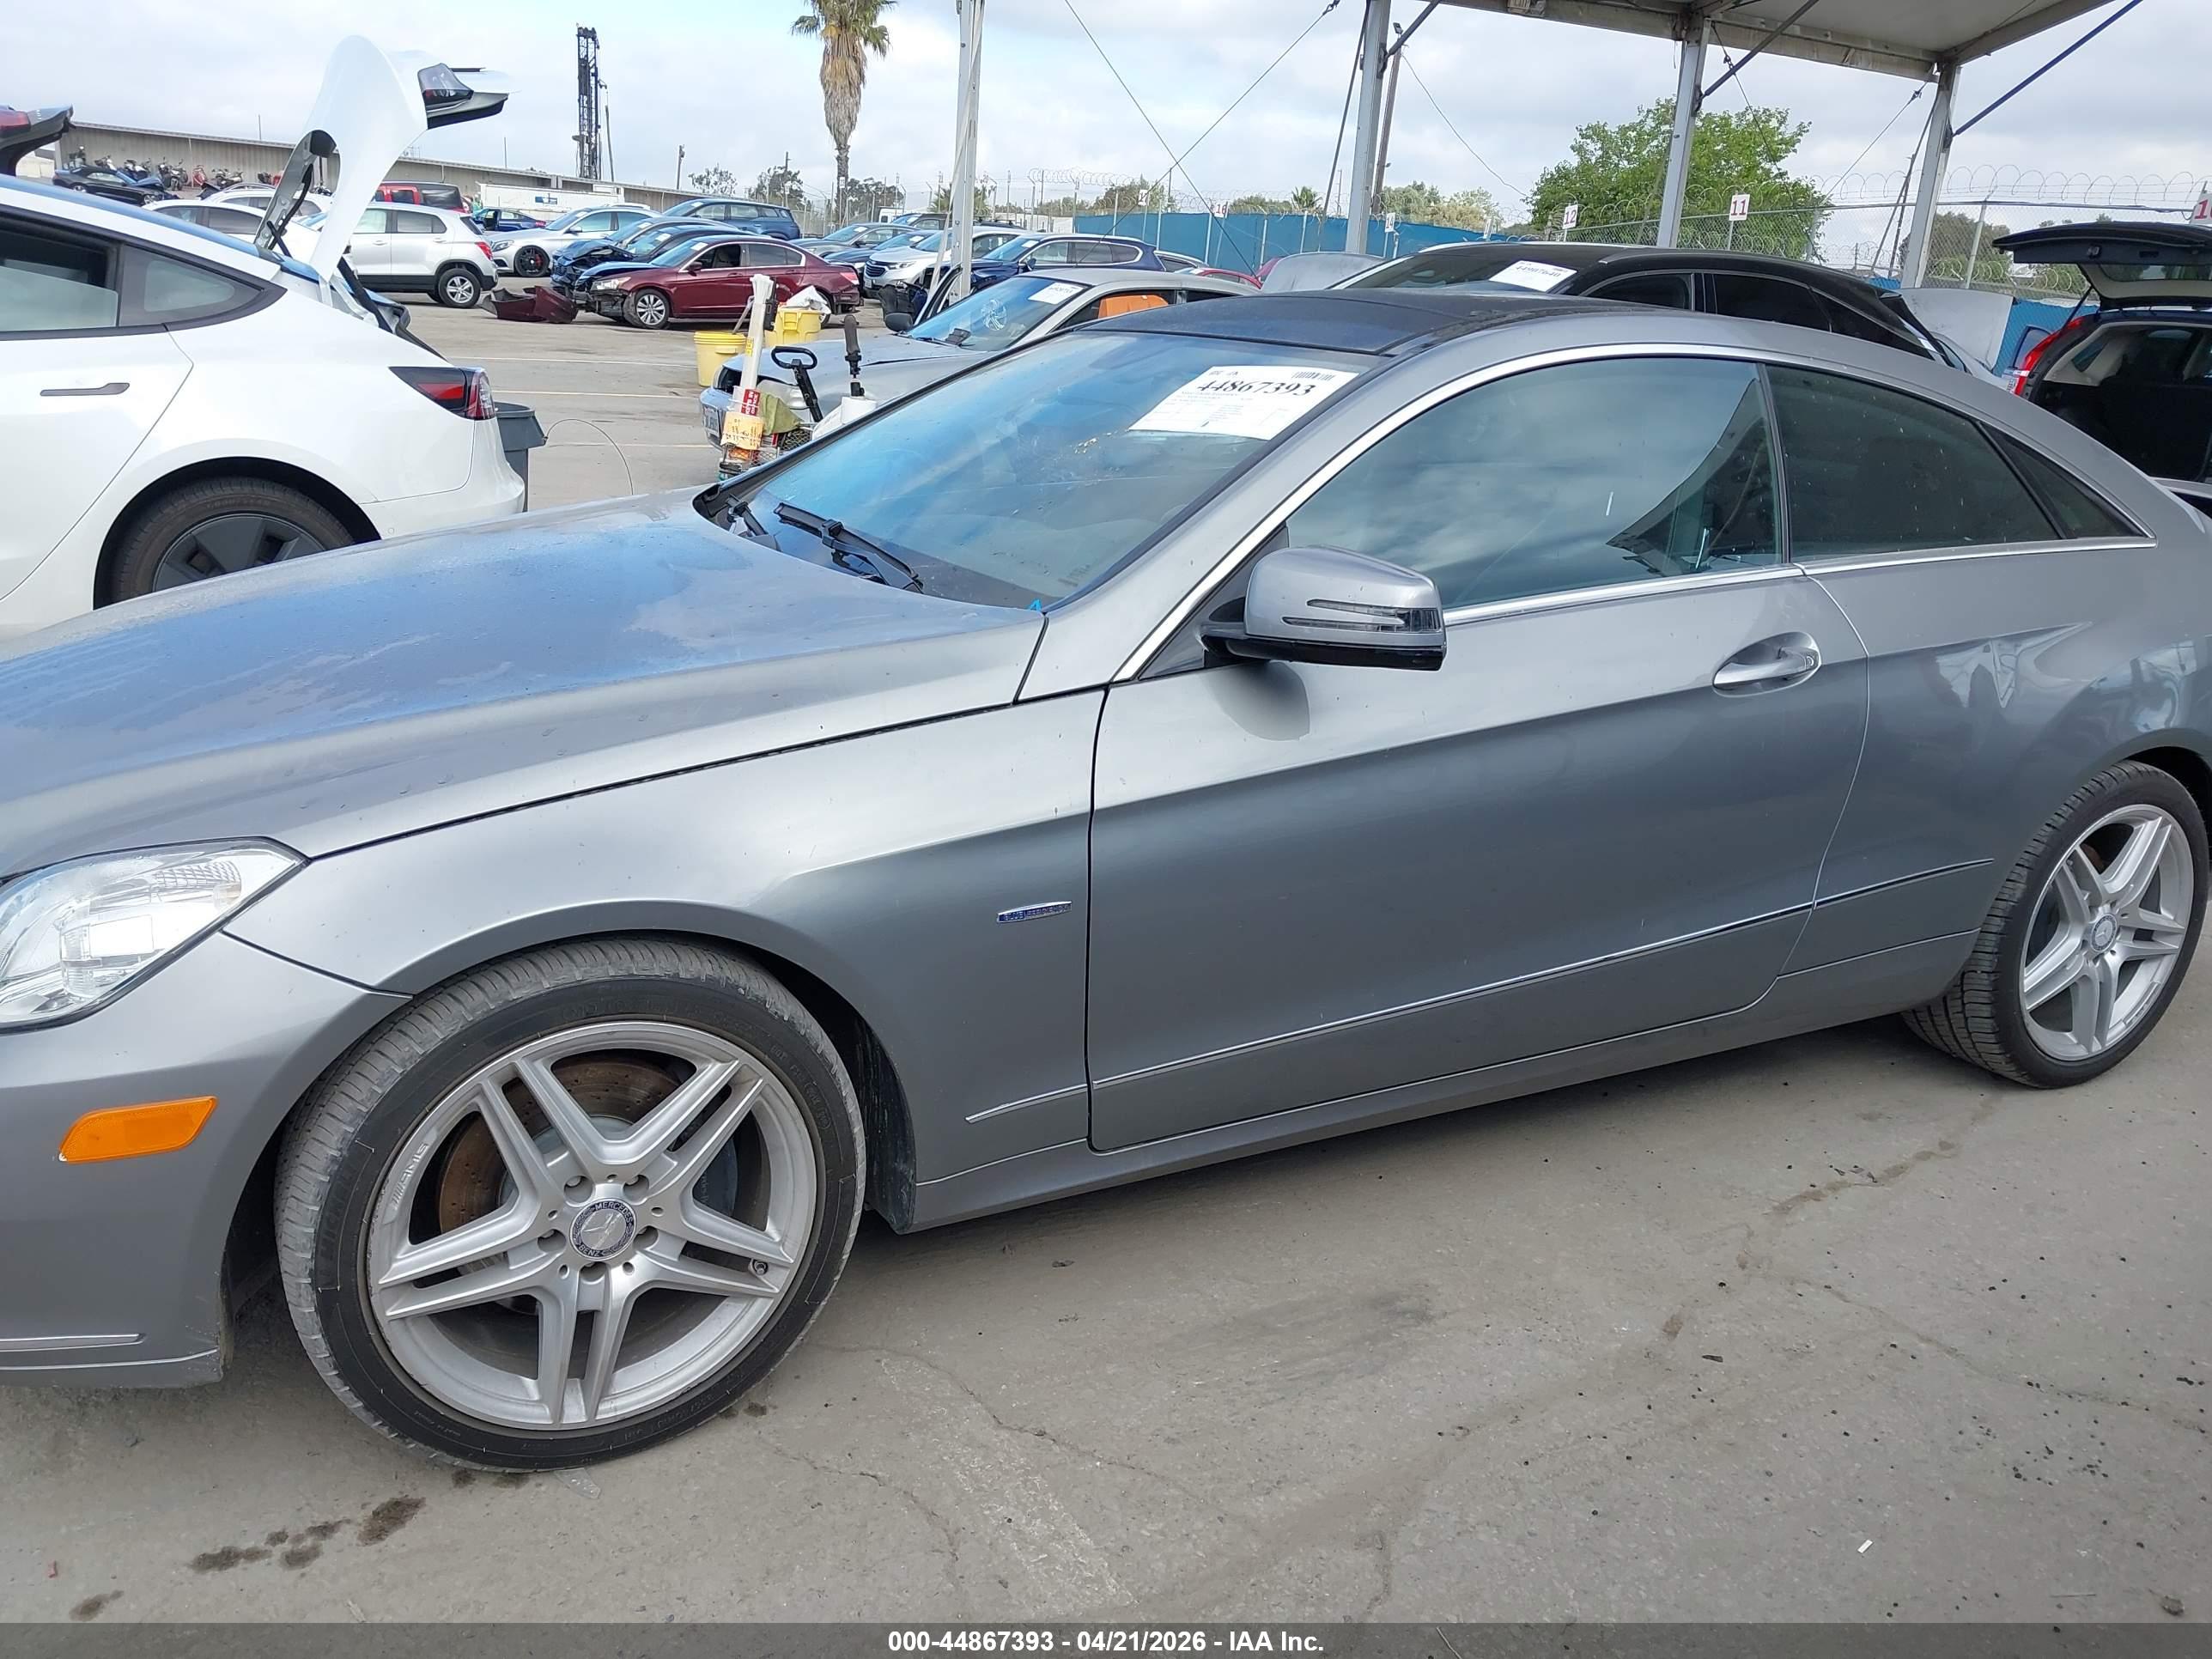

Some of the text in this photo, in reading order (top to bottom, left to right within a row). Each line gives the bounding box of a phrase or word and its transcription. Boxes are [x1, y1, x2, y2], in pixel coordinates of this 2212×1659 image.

[1731, 198, 1747, 216] 11
[2194, 199, 2212, 219] 1
[1565, 210, 1577, 225] 12
[1197, 380, 1316, 396] 44867393
[595, 1201, 633, 1224] MERCEDES
[578, 1244, 600, 1257] BENZ
